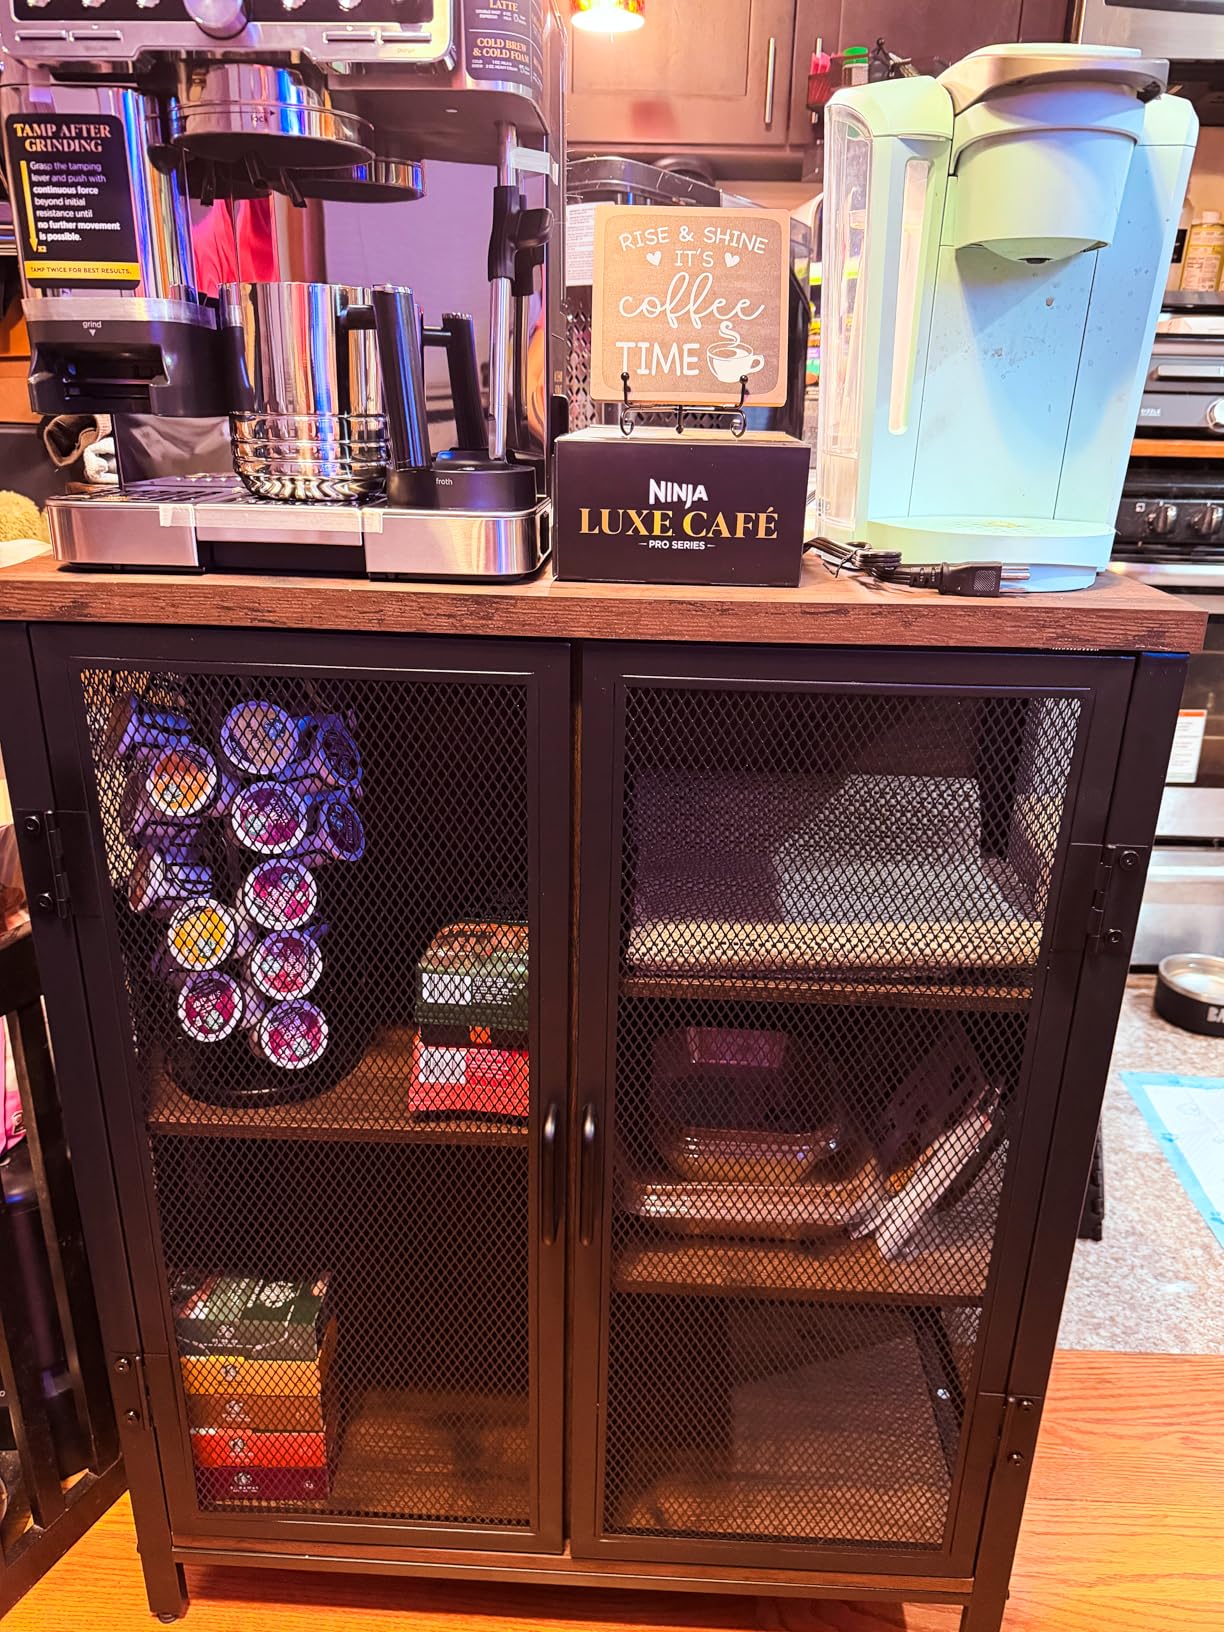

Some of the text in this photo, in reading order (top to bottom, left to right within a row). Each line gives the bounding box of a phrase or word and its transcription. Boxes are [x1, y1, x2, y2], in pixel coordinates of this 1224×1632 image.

[490, 0, 518, 12] LATTE
[477, 38, 527, 52] COLD BREW
[472, 47, 529, 64] & COLD FOAM
[13, 123, 111, 138] TAMP AFTER
[24, 139, 103, 153] GRINDING
[30, 161, 102, 172] Grasp the tamping
[31, 174, 107, 184] lever and push with
[33, 186, 99, 195] continuous force
[34, 197, 86, 207] beyond initial
[36, 209, 93, 218] resistance until
[49, 221, 76, 229] further
[77, 222, 121, 230] movement
[39, 232, 82, 242] is possible.
[618, 225, 769, 254] RISE & SHINE
[674, 248, 714, 268] IT'S
[618, 271, 765, 329] coffee
[82, 320, 102, 329] grind
[615, 341, 700, 377] TIME
[435, 477, 453, 486] froth
[648, 478, 709, 510] NINJA
[579, 506, 778, 539] LUXE CAFÉ
[649, 540, 706, 550] PRO SERIES
